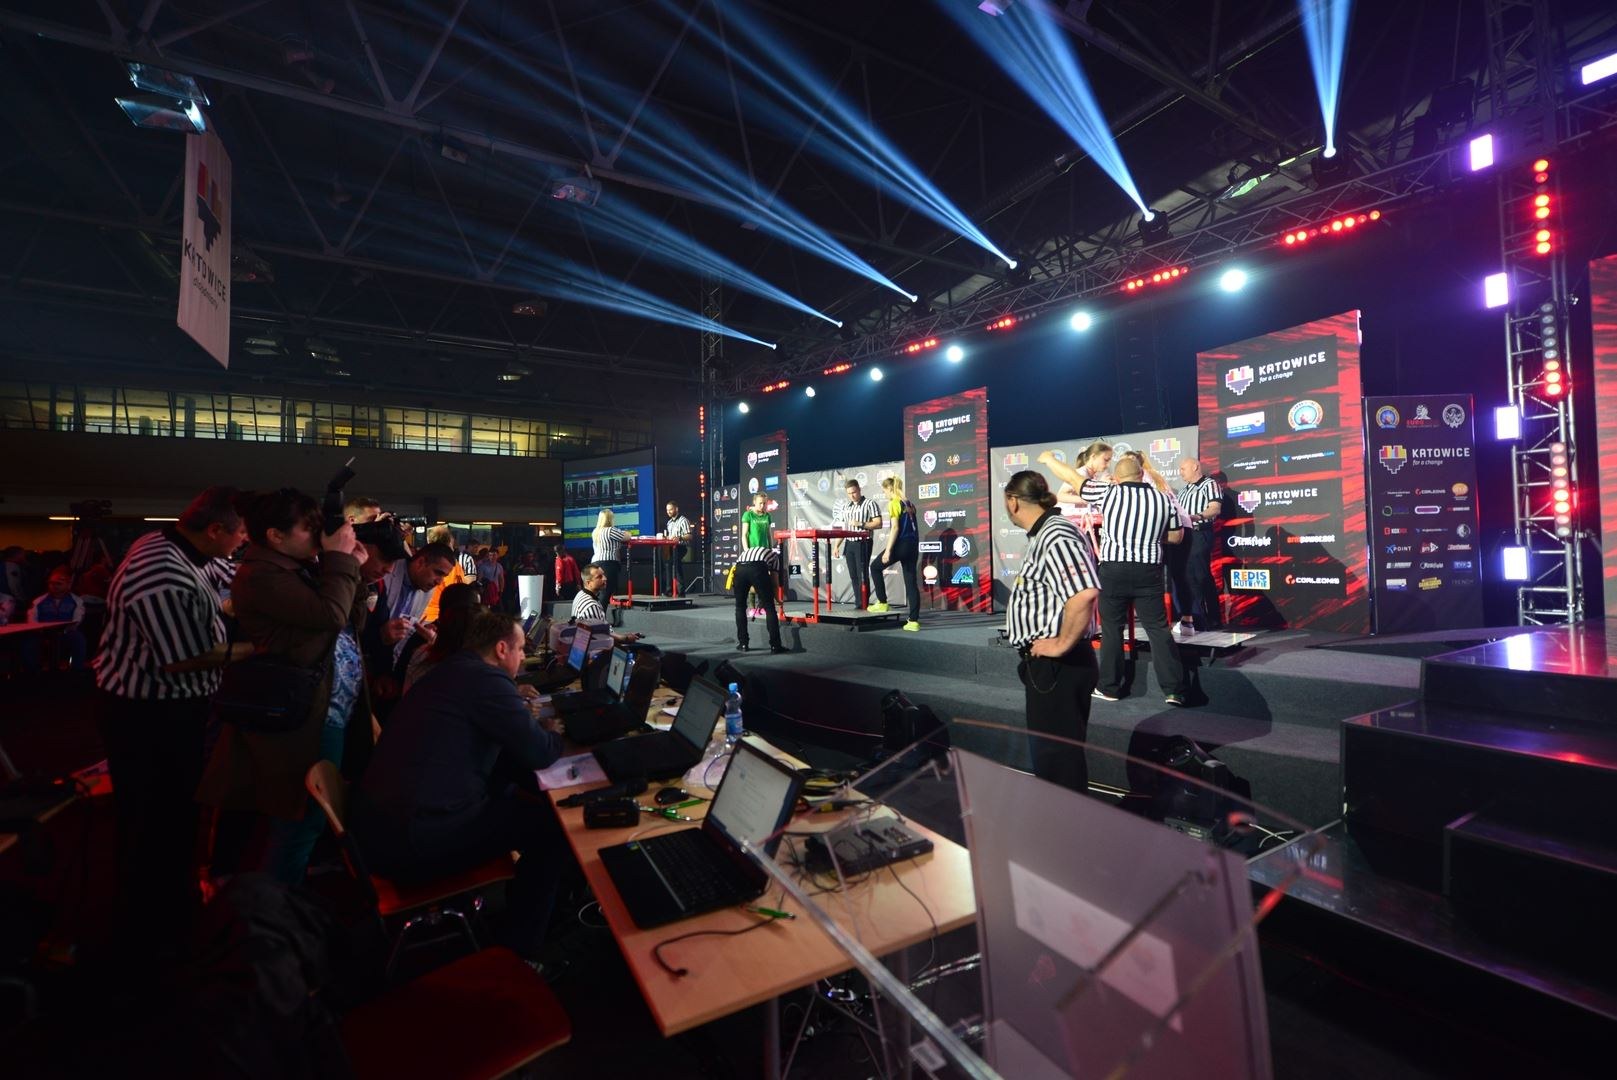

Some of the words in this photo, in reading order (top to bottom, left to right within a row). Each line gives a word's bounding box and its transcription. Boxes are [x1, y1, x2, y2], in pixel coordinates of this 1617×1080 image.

[184, 238, 226, 302] KATOWICE
[1258, 351, 1326, 376] KATOWICE
[1258, 376, 1268, 384] for
[1272, 371, 1294, 380] change
[935, 414, 971, 429] KATOWICE
[1412, 448, 1471, 458] KATOWICE
[1264, 488, 1318, 500] KATOWICE
[1234, 571, 1266, 580] REDIS
